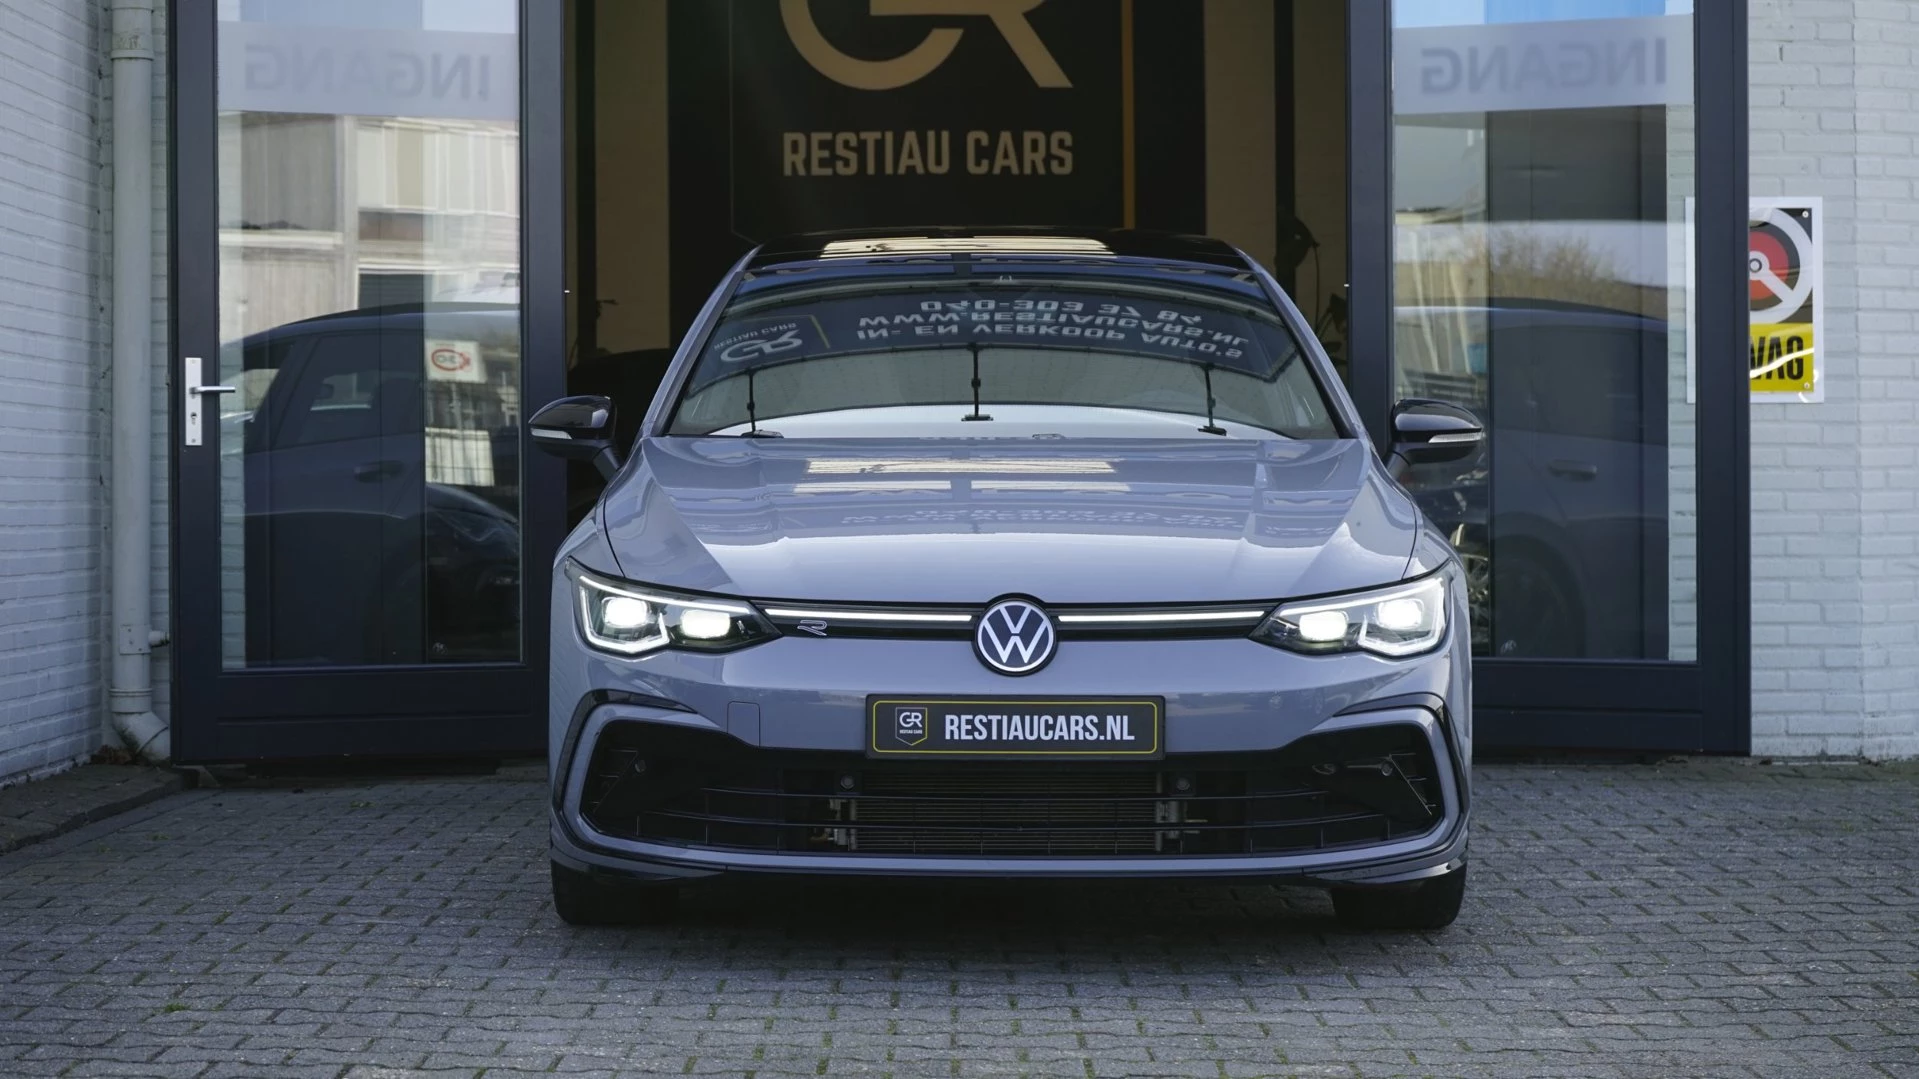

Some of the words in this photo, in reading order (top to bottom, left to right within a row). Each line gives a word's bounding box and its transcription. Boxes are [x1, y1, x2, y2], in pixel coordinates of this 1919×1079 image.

[783, 130, 950, 177] RESTIAU
[966, 130, 1074, 176] CARS
[797, 619, 827, 636] R
[899, 711, 923, 728] GR
[944, 714, 1135, 740] RESTIAUCARS.NL
